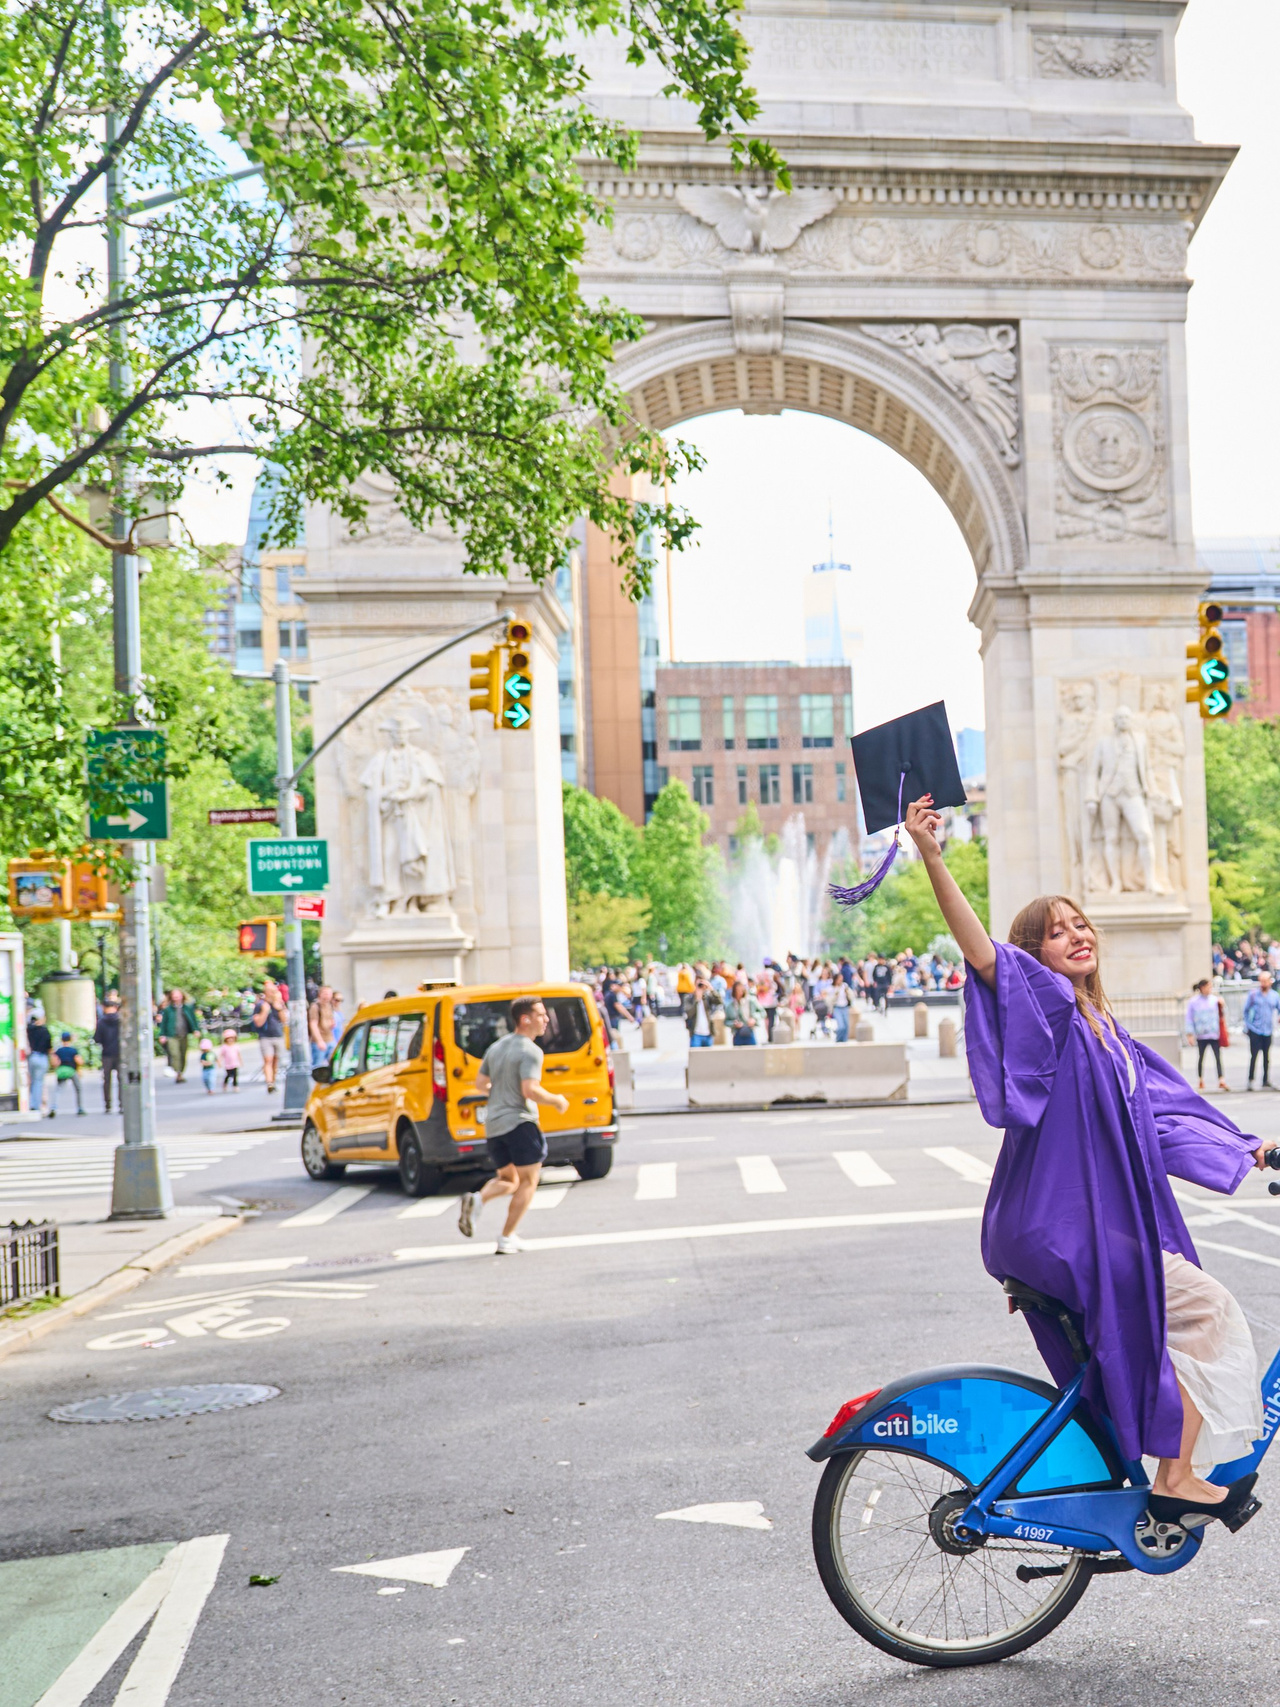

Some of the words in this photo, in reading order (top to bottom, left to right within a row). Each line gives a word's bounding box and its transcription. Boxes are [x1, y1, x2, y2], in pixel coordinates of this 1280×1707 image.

[760, 20, 866, 36] HUNDREDTH
[871, 24, 987, 40] ANNIVERSARY
[770, 37, 844, 54] GEORGE
[855, 39, 986, 58] WASHINGTON
[766, 53, 802, 70] THE
[813, 55, 885, 73] UNITED
[897, 58, 971, 75] STATES
[257, 845, 319, 857] BROADWAY
[257, 858, 321, 871] DOWNTOWN
[873, 1414, 908, 1437] citi
[912, 1413, 958, 1435] bike
[1014, 1525, 1054, 1541] 41997
